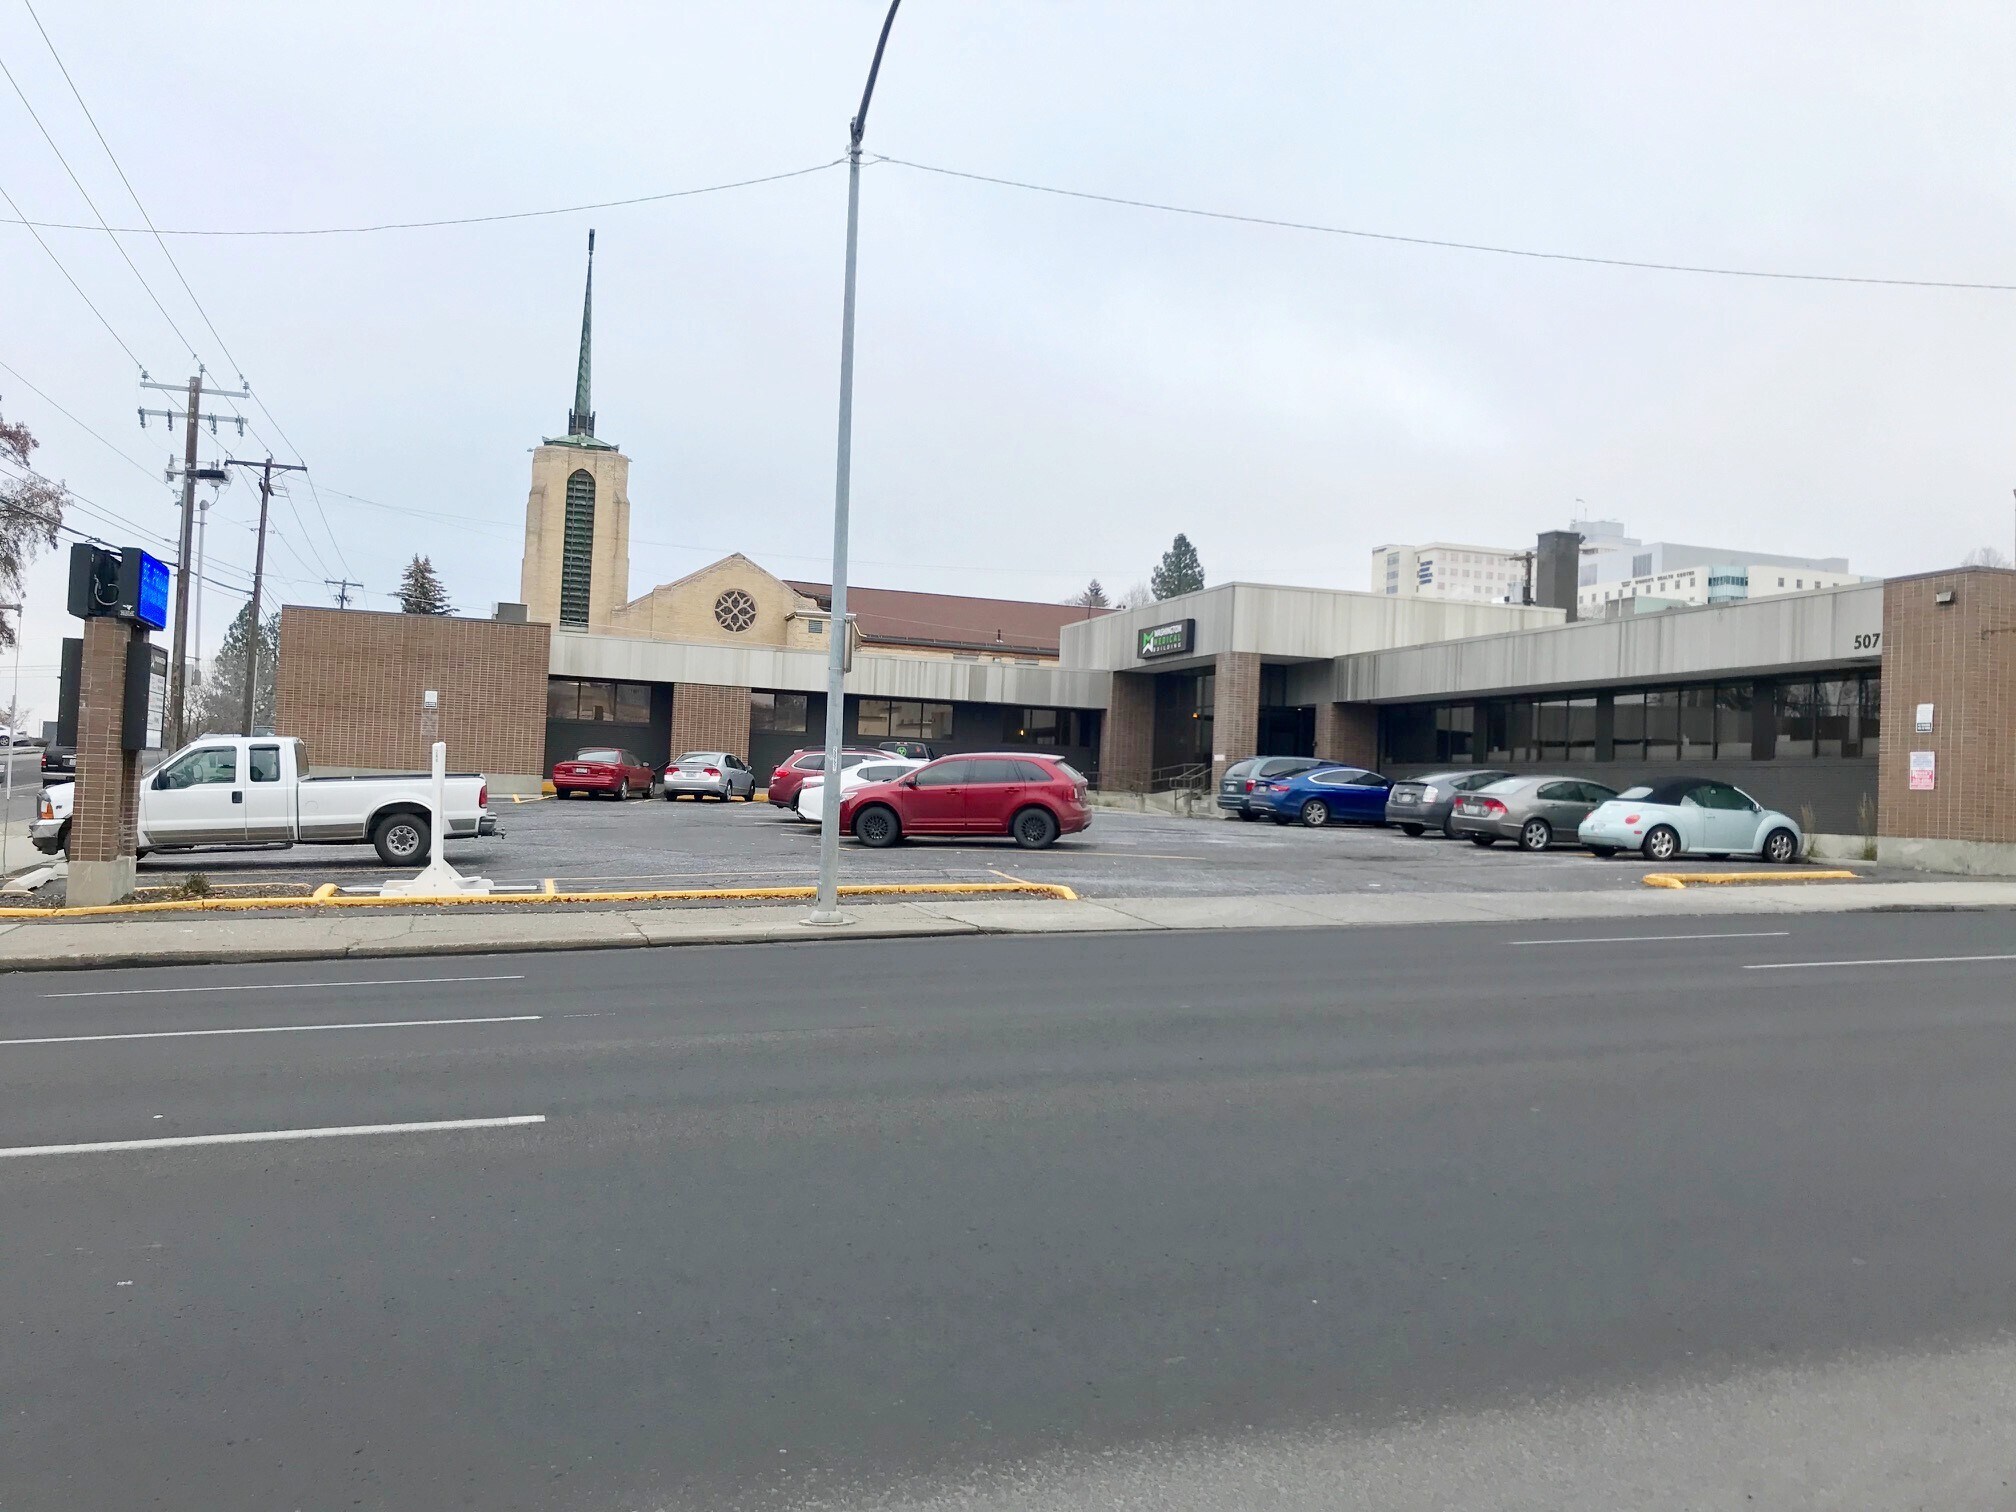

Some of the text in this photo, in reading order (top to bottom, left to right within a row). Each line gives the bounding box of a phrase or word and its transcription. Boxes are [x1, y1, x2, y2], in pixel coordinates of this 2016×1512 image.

[1153, 633, 1181, 645] MEDICAL
[1854, 633, 1881, 650] 507
[1153, 642, 1181, 652] BUILDING
